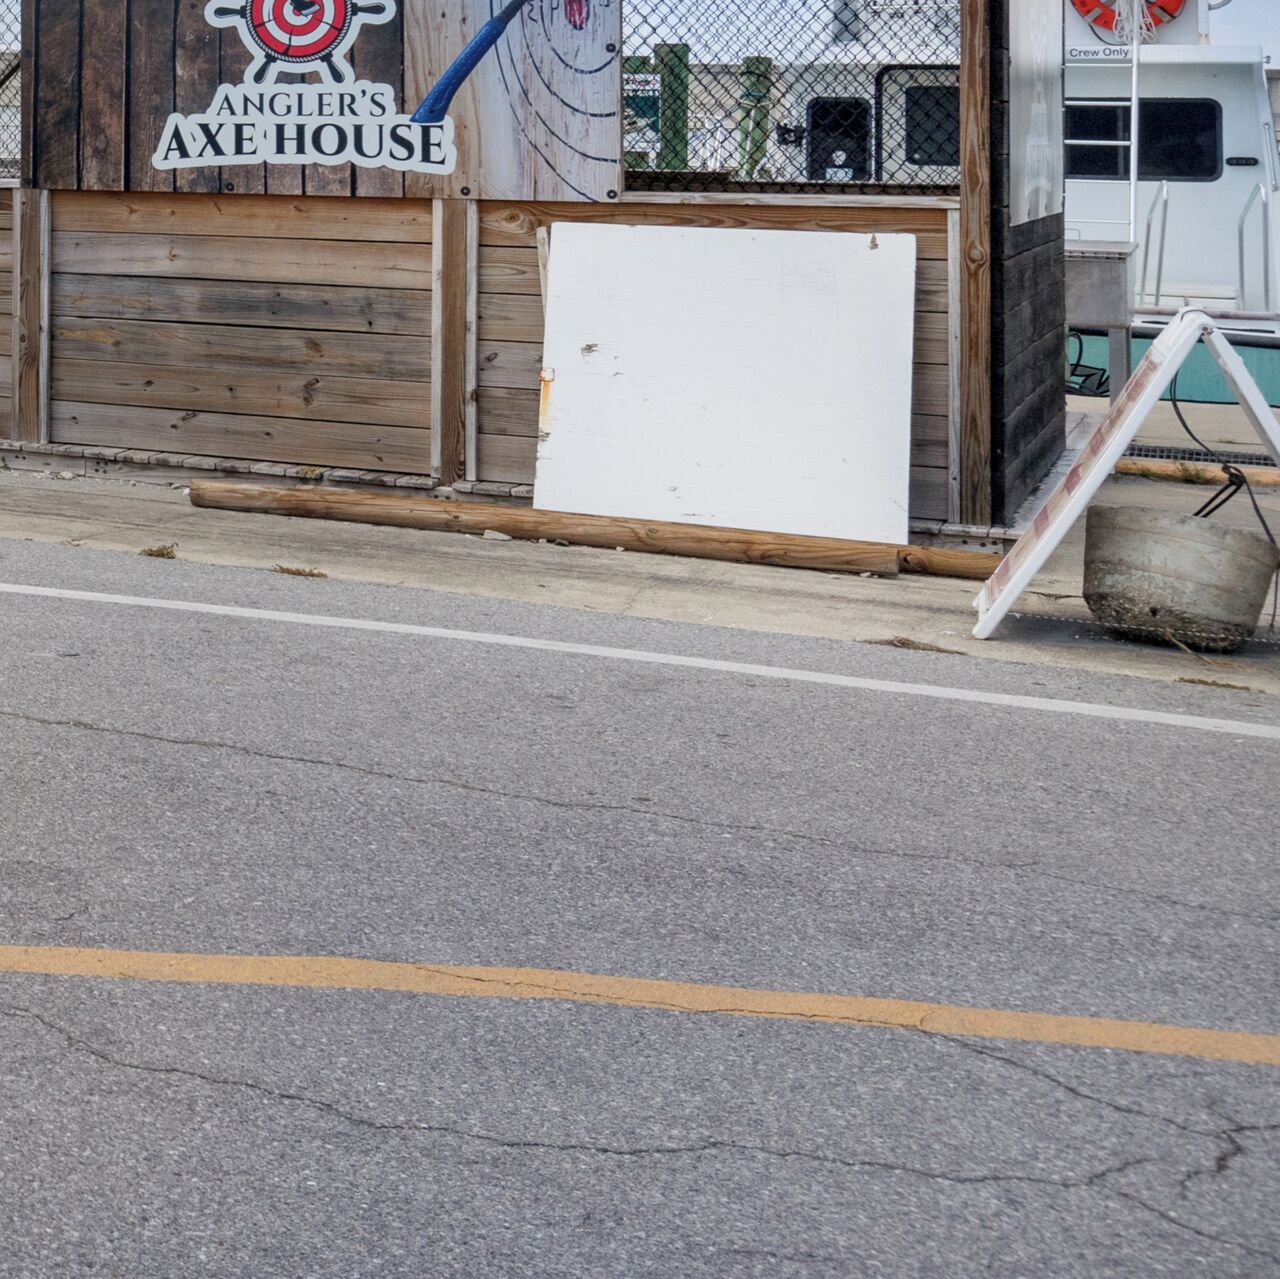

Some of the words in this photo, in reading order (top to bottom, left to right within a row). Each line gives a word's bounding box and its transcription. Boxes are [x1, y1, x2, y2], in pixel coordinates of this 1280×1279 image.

[1069, 48, 1100, 57] Crew
[1102, 47, 1130, 58] Only
[216, 89, 387, 117] ANGLER'S
[162, 123, 258, 161] AXE
[274, 123, 447, 166] HOUSE
